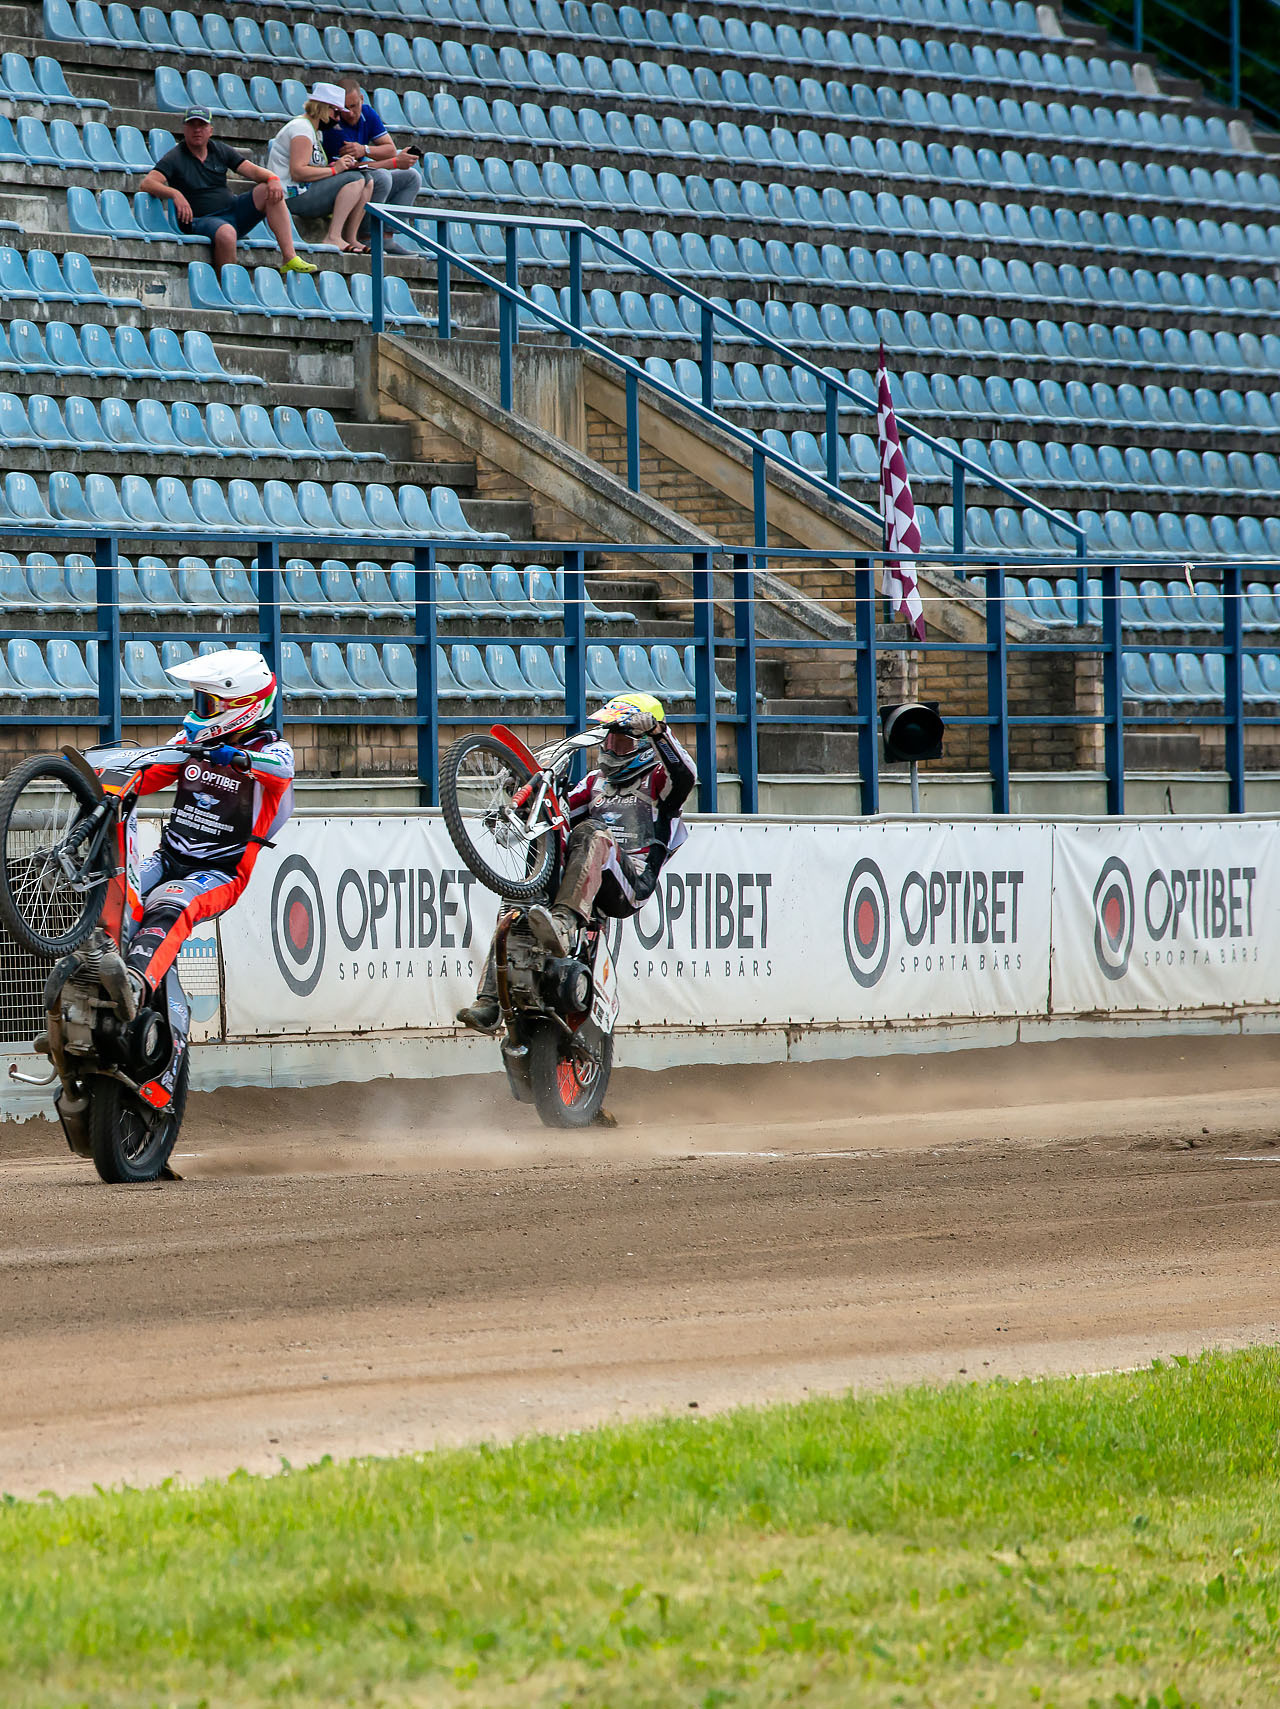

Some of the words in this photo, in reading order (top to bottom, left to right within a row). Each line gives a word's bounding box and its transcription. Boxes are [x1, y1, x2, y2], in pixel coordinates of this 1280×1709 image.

[202, 771, 241, 790] OPTIBET
[337, 868, 477, 951] OPTIBET
[633, 873, 772, 950] OPTIBET
[900, 871, 1023, 946] OPTIBET
[1145, 867, 1255, 941] OPTIBET
[633, 960, 711, 977] SPORTA
[725, 956, 772, 977] BĀRS
[901, 954, 968, 972] SPORTA
[1144, 949, 1210, 967] SPORTA
[340, 960, 413, 980] SPORTA
